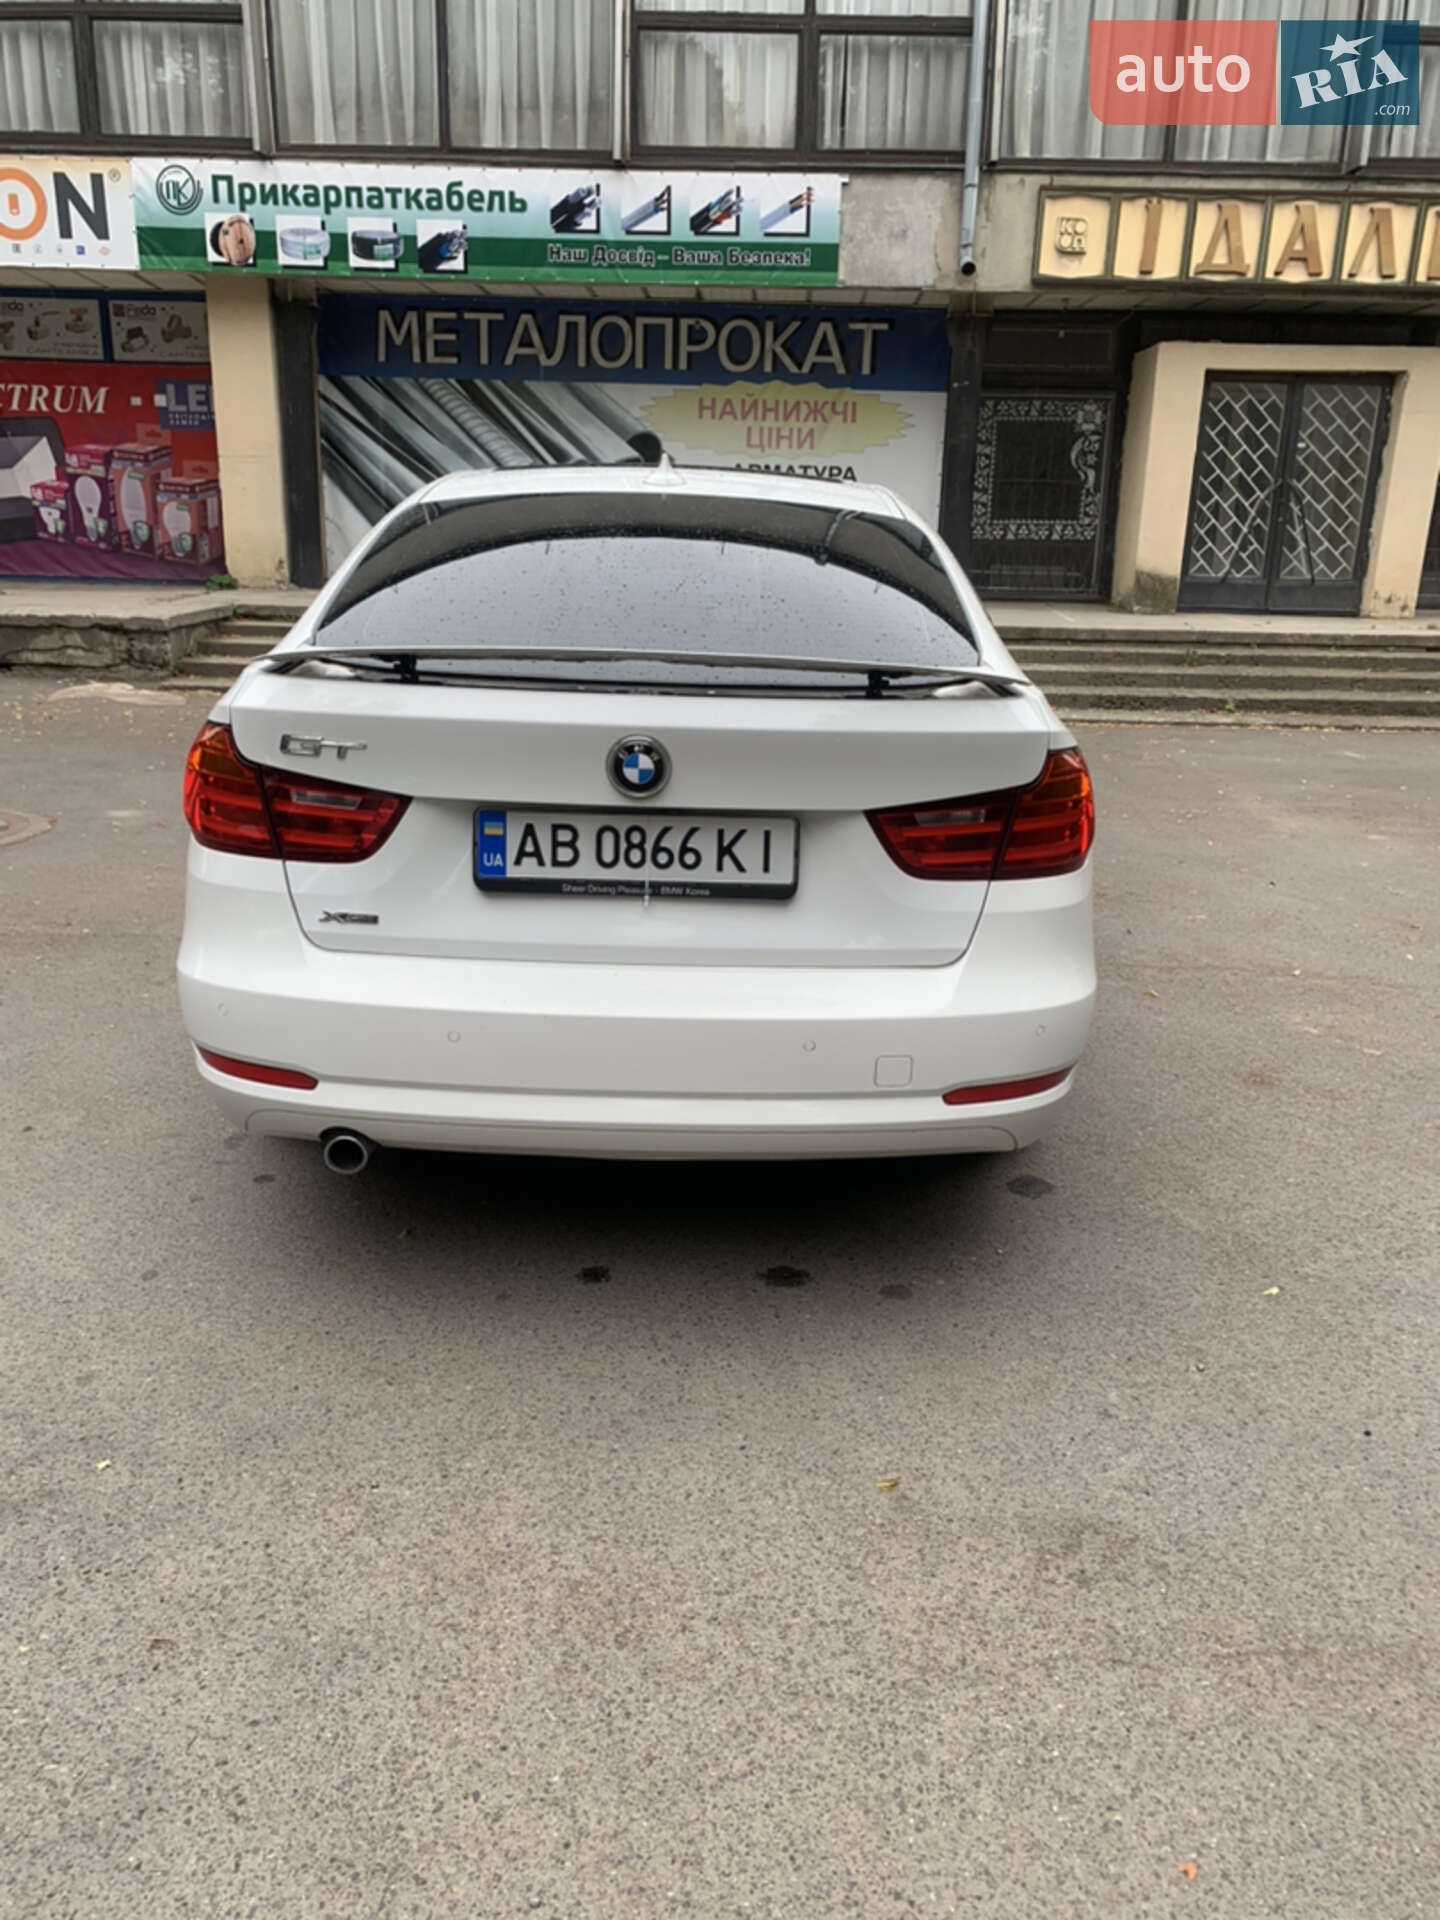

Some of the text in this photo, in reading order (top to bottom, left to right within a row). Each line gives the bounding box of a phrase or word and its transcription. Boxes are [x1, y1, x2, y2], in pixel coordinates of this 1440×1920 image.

[211, 174, 529, 214] Прикарпаткабель
[548, 243, 588, 263] Наш
[592, 244, 655, 267] Досвід
[672, 247, 723, 265] Ваша
[727, 248, 812, 267] Безпека!
[376, 308, 889, 377] МЕТАЛОПРОКАТ
[0, 383, 109, 414] TRUM
[166, 383, 214, 412] LE
[697, 395, 858, 425] НАЙНИЖЧІ
[745, 427, 817, 453] ЦІНИ
[483, 853, 504, 868] UA
[513, 822, 772, 873] AB 0866 KI
[587, 883, 616, 896] Driving
[685, 886, 711, 896] Korea
